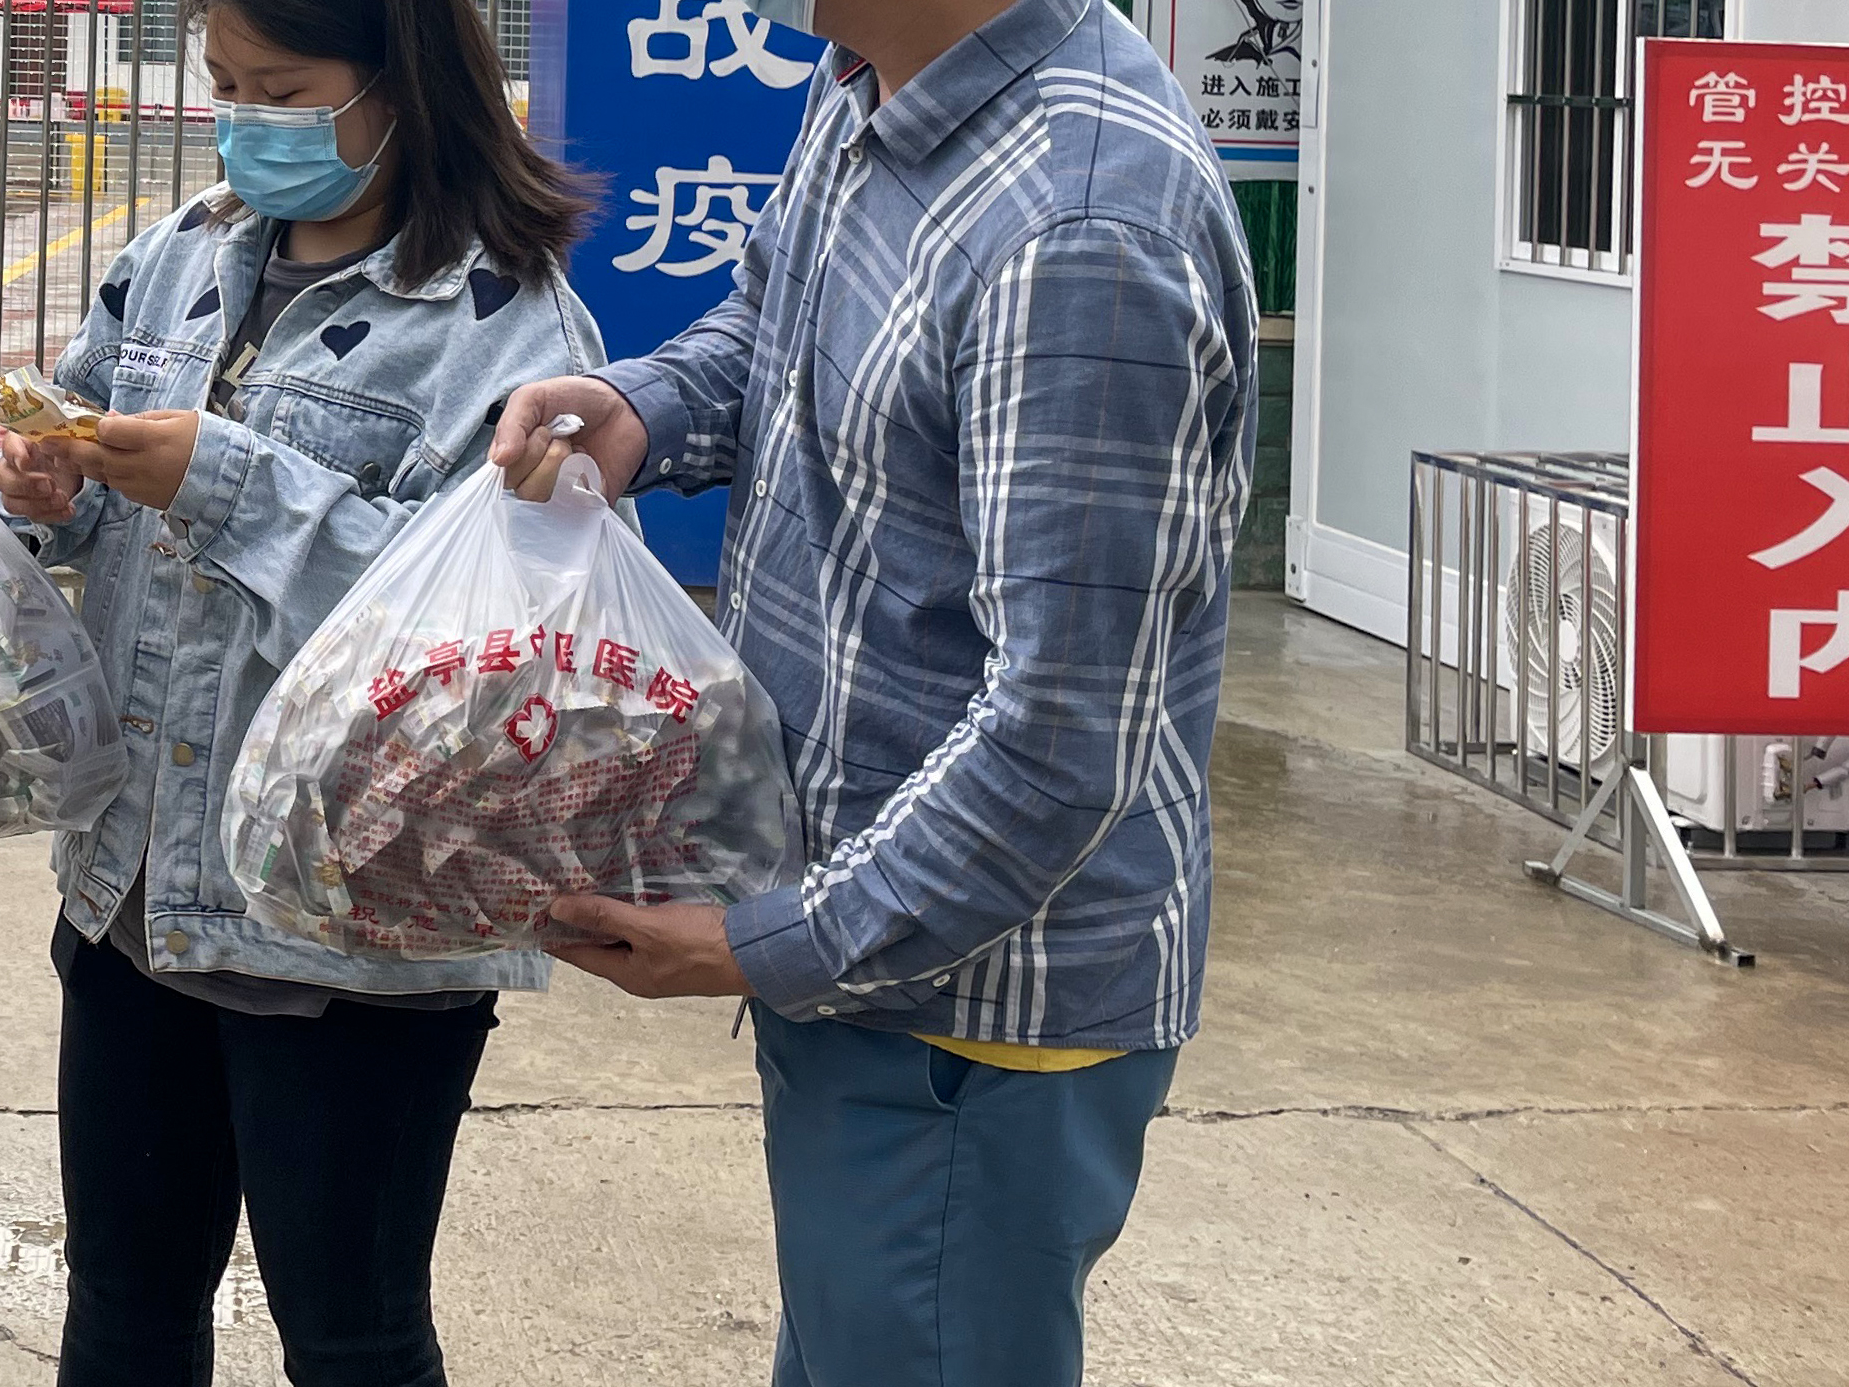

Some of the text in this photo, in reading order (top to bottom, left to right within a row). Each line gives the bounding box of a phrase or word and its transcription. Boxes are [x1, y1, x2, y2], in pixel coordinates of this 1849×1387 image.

[1201, 74, 1300, 99] 进入施工
[1689, 71, 1849, 125] 管控
[1201, 108, 1299, 131] 必须戴安
[1685, 140, 1849, 192] 无关
